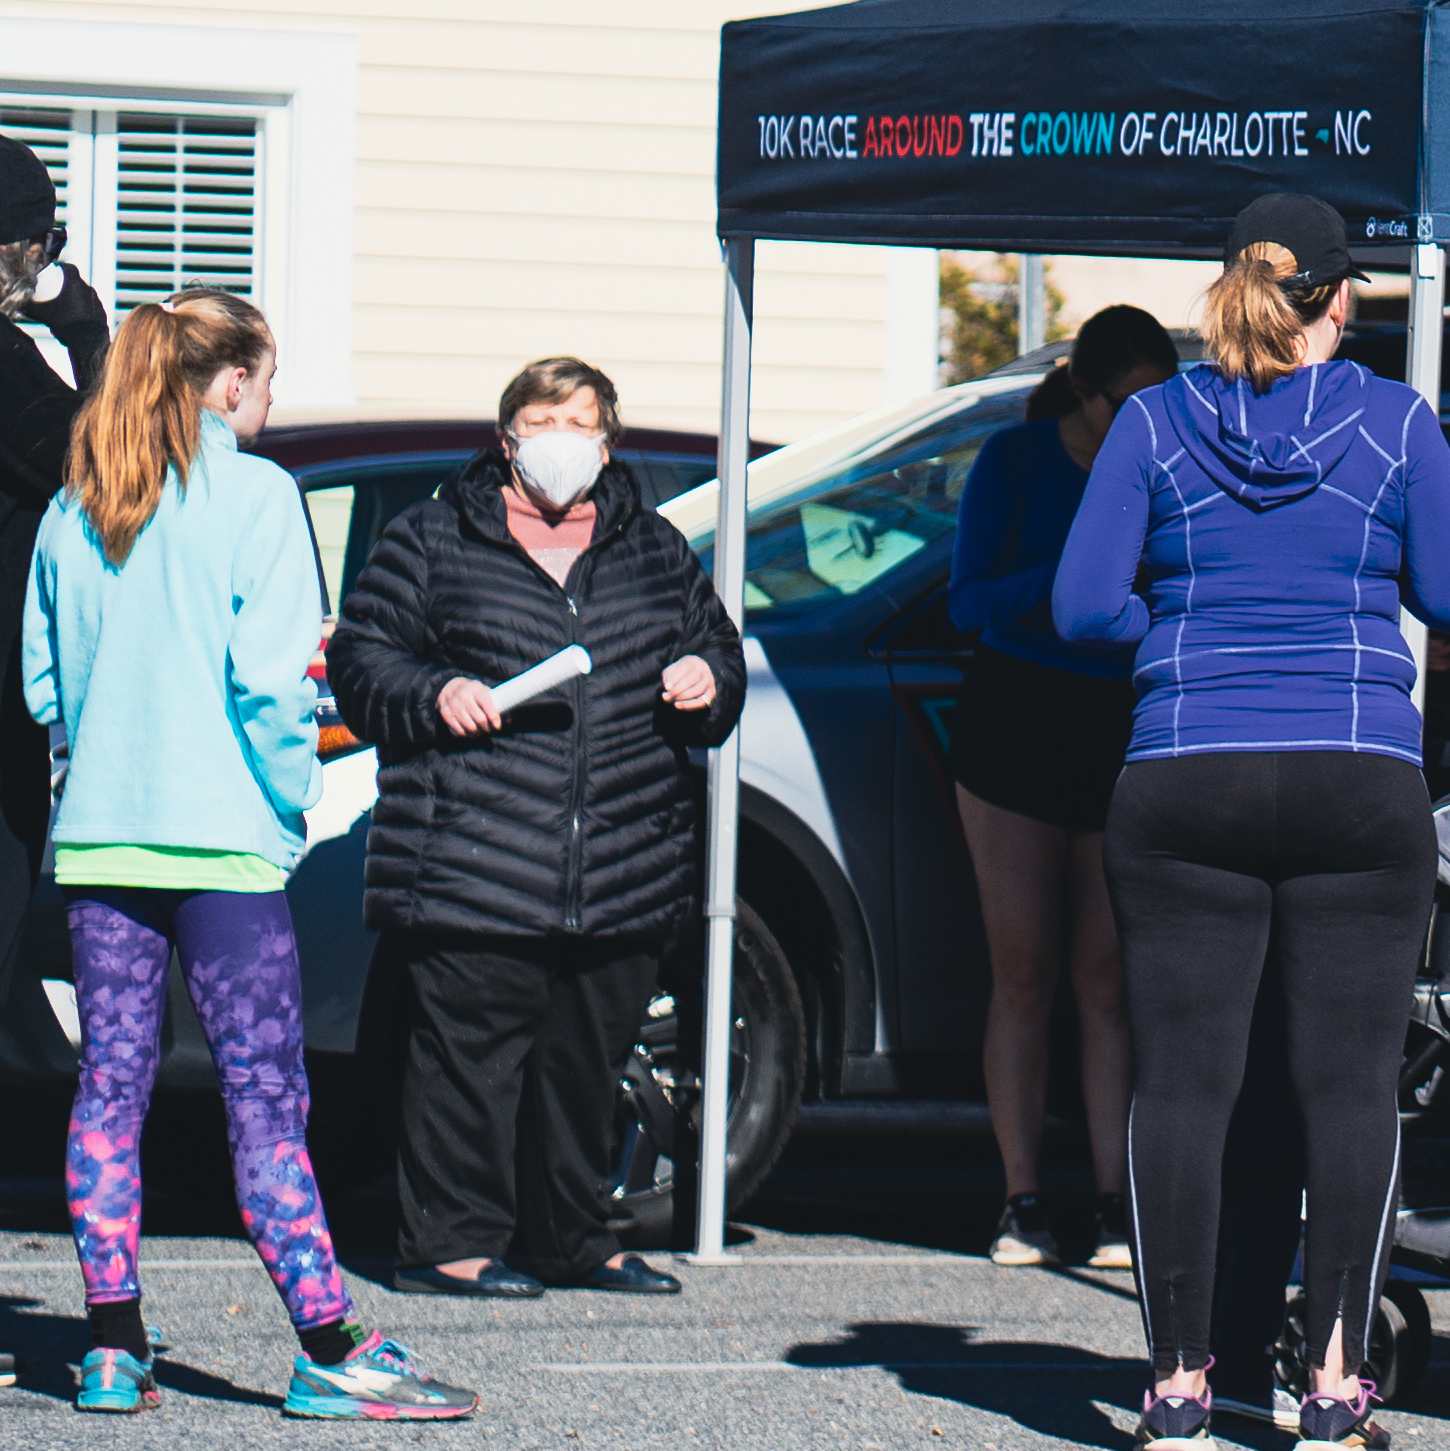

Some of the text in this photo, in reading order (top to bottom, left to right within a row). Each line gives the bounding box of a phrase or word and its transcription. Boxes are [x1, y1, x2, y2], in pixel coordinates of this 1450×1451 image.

[757, 109, 1372, 159] 10K RACE AROUND THE CROWN OF CHARLOTTE NC
